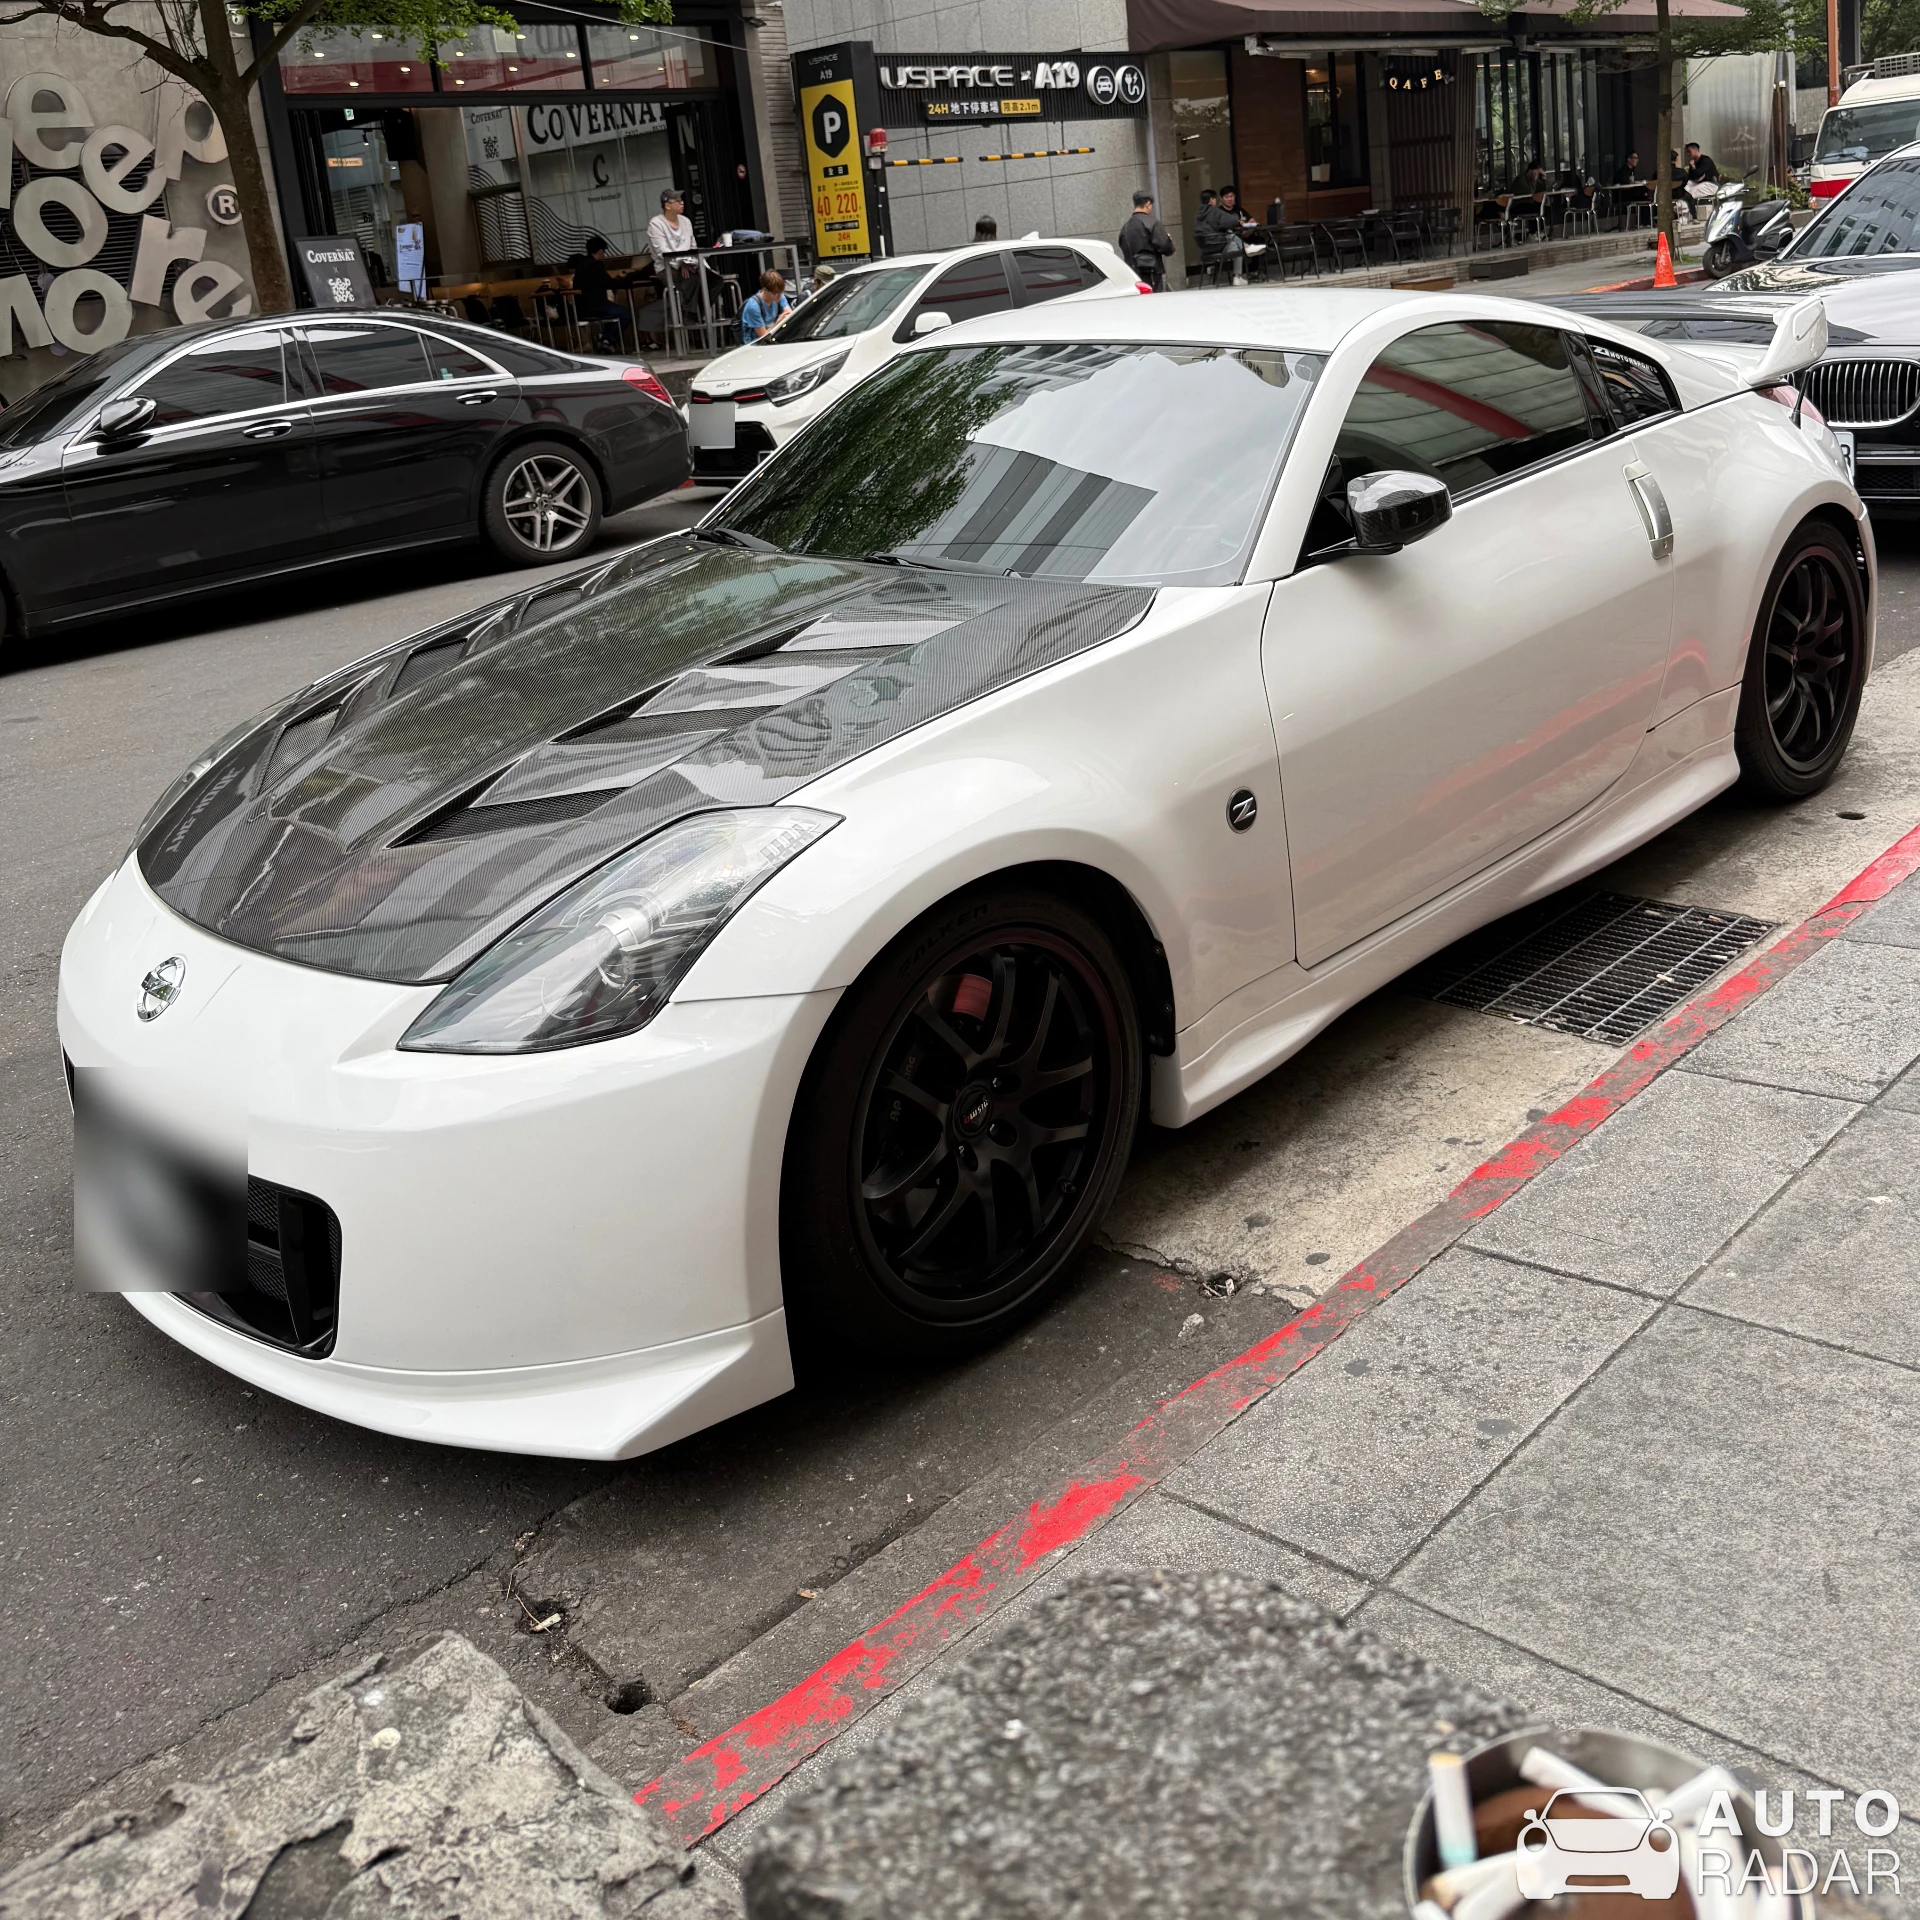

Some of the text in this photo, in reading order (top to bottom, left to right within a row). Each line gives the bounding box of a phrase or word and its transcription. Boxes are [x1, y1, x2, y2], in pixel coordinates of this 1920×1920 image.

[820, 69, 832, 80] A19
[880, 65, 1014, 90] USPACE
[1034, 61, 1080, 90] A19
[928, 101, 999, 115] 24H 地下停車場
[823, 111, 841, 144] P
[817, 192, 858, 217] 40 220
[307, 250, 356, 264] COVERNAT
